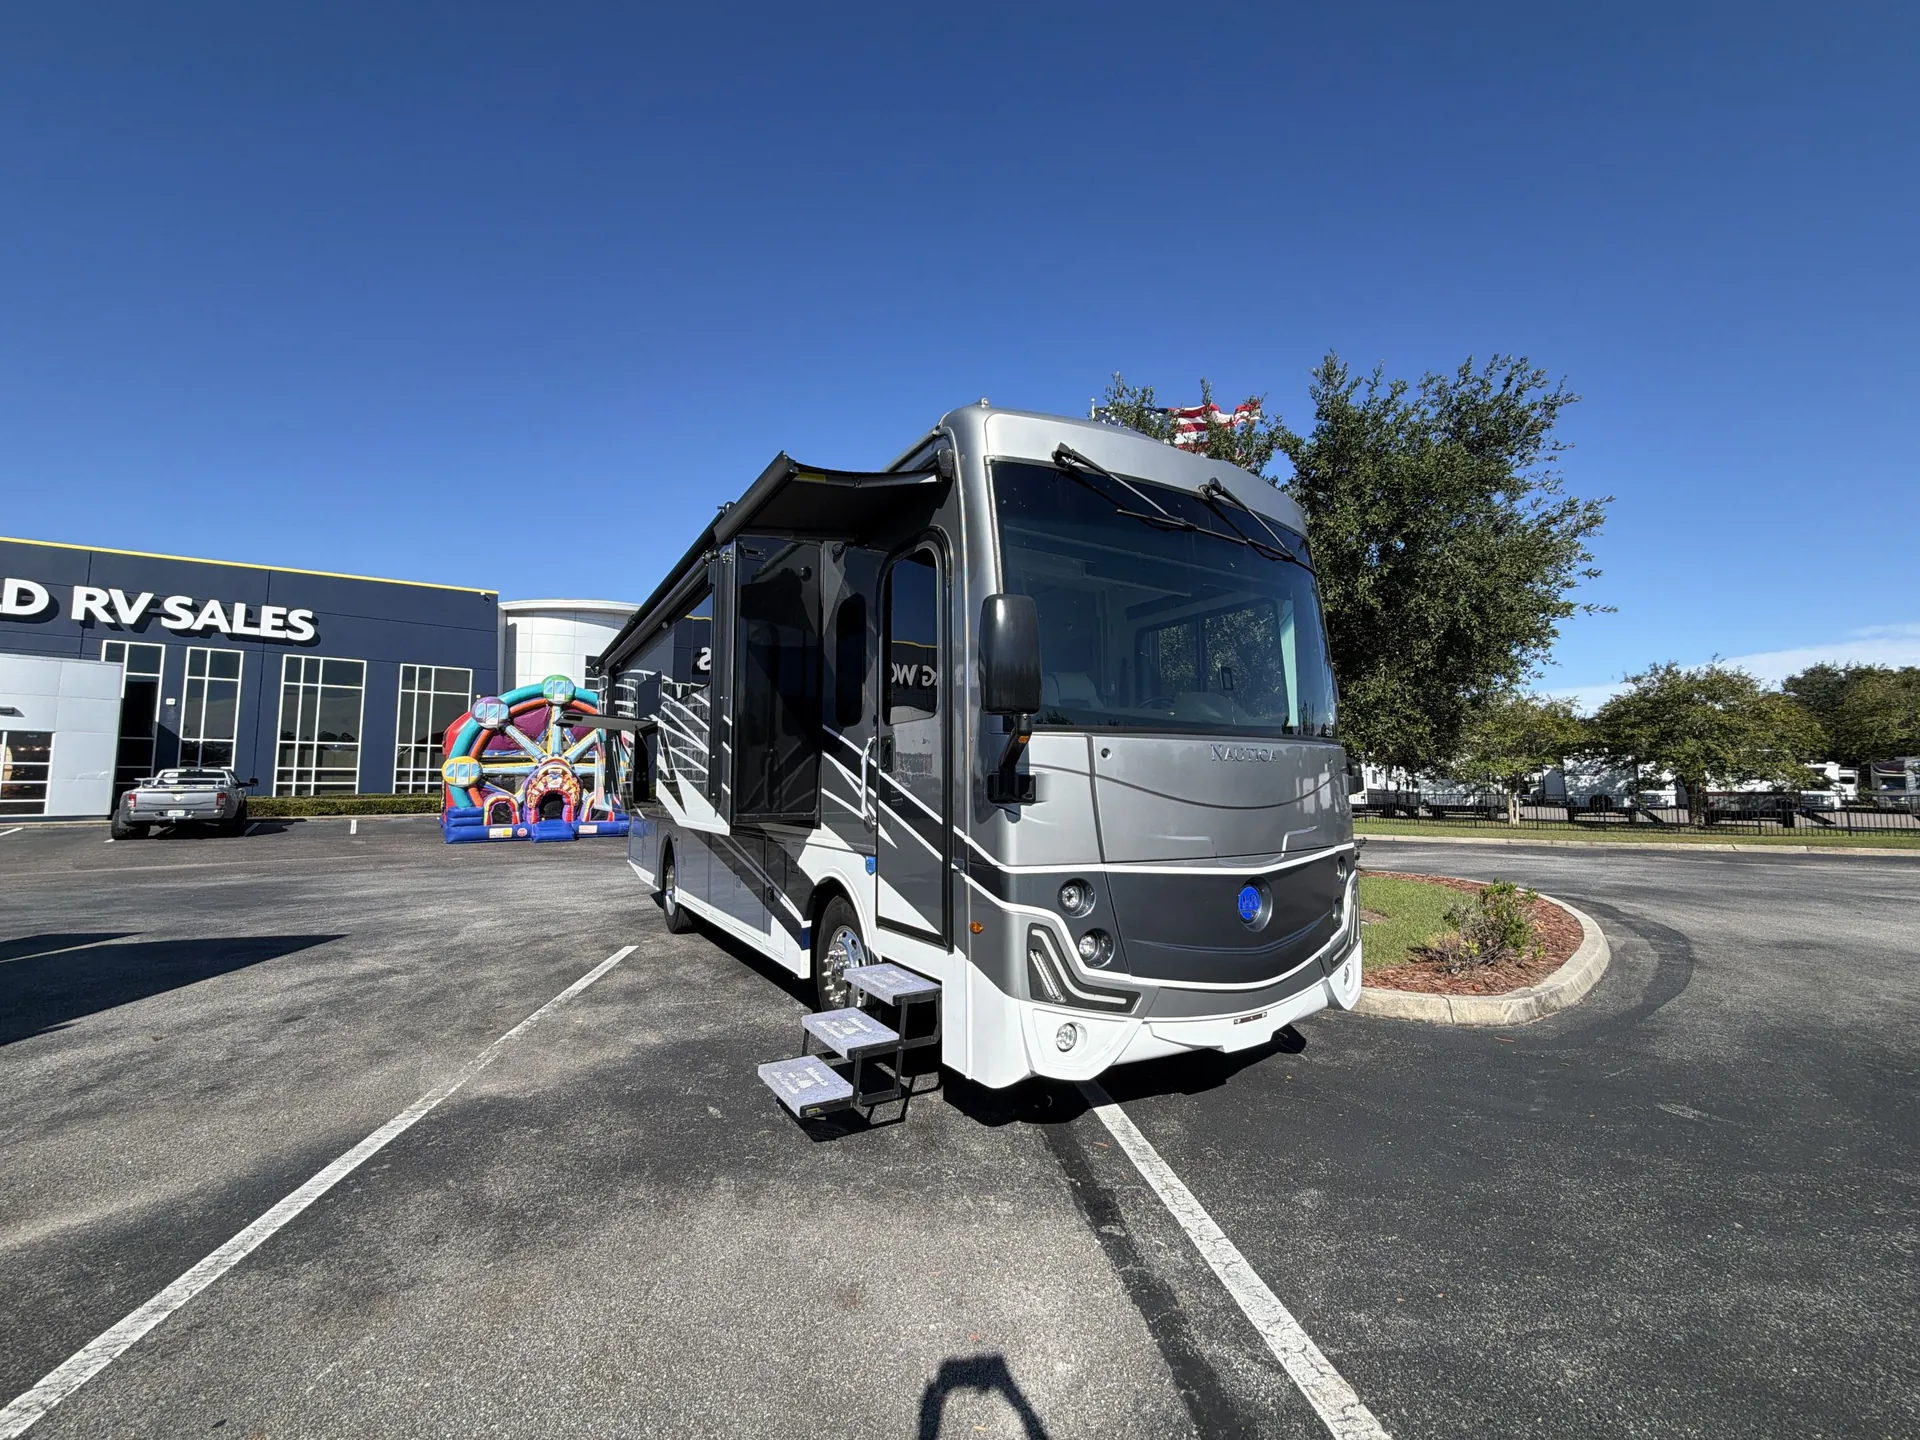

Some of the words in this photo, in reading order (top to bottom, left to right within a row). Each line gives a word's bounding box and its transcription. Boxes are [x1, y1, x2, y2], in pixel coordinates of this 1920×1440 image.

[0, 577, 50, 615] D
[71, 585, 154, 625] RV
[161, 595, 316, 641] SALES
[1210, 743, 1279, 763] NAUTICA
